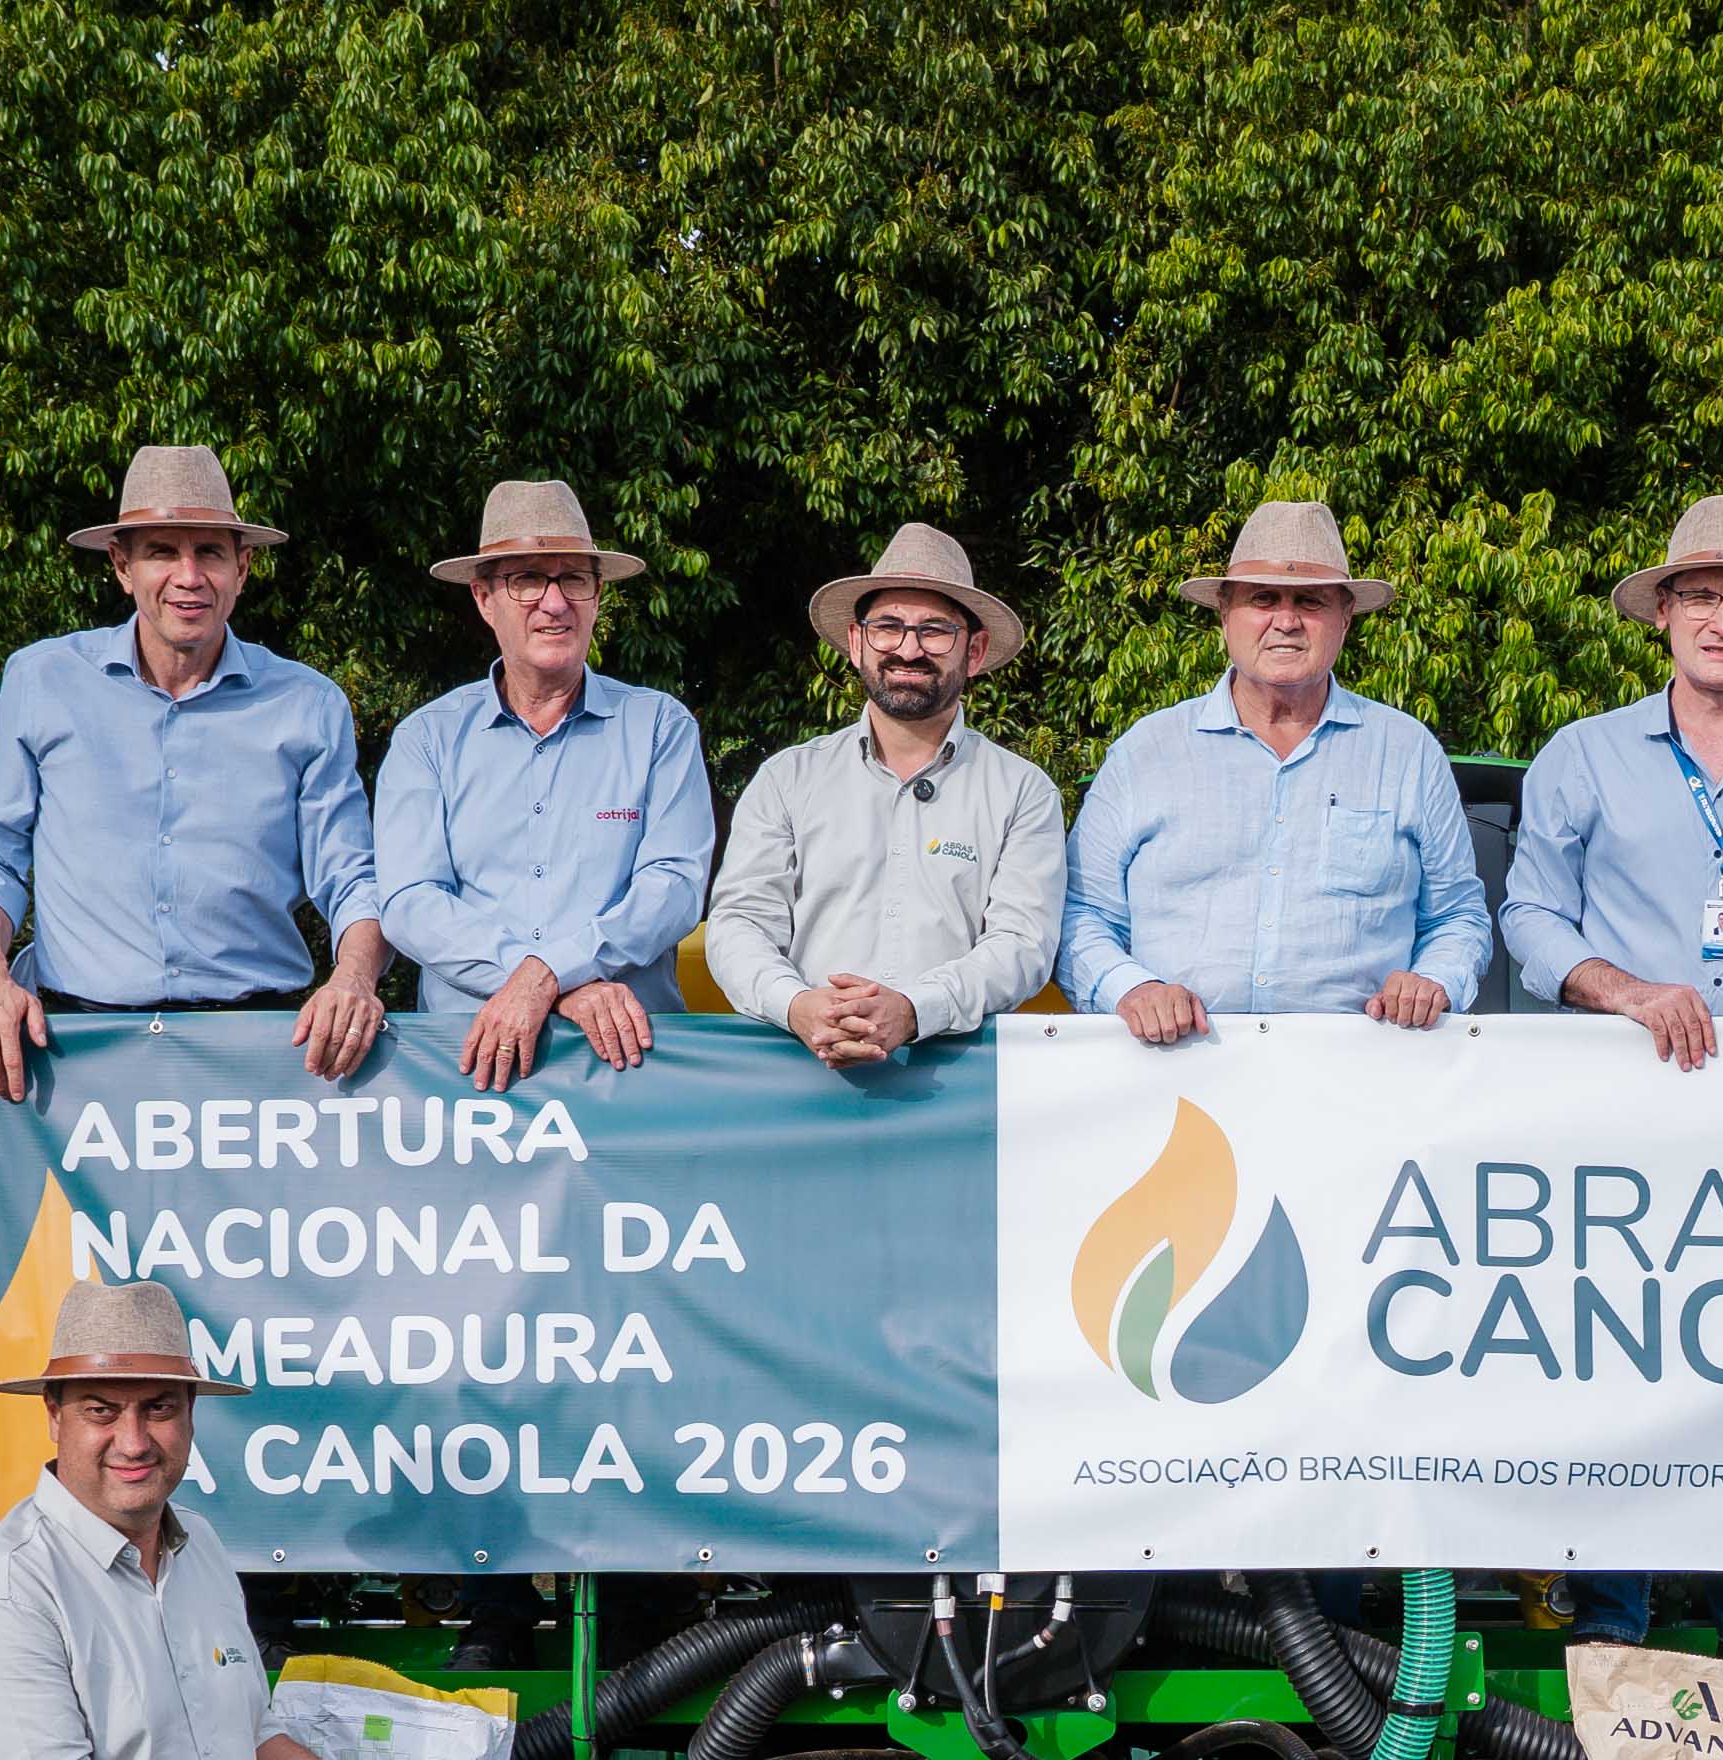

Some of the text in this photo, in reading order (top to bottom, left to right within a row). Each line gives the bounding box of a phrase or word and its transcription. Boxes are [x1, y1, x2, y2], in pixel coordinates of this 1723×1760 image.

[596, 808, 640, 824] cotrijal
[941, 848, 978, 863] CANOLA
[943, 841, 973, 854] ABRAS
[61, 1096, 588, 1172] ABERTURA
[72, 1202, 747, 1280] NACIONAL DA
[188, 1313, 673, 1387] MEADURA
[243, 1422, 645, 1496] CANOLA
[675, 1421, 906, 1495] 2026
[1073, 1451, 1288, 1488] ASSOCIAÇÃO
[1299, 1456, 1484, 1485] BRASILEIRA
[1493, 1460, 1562, 1488] DOS
